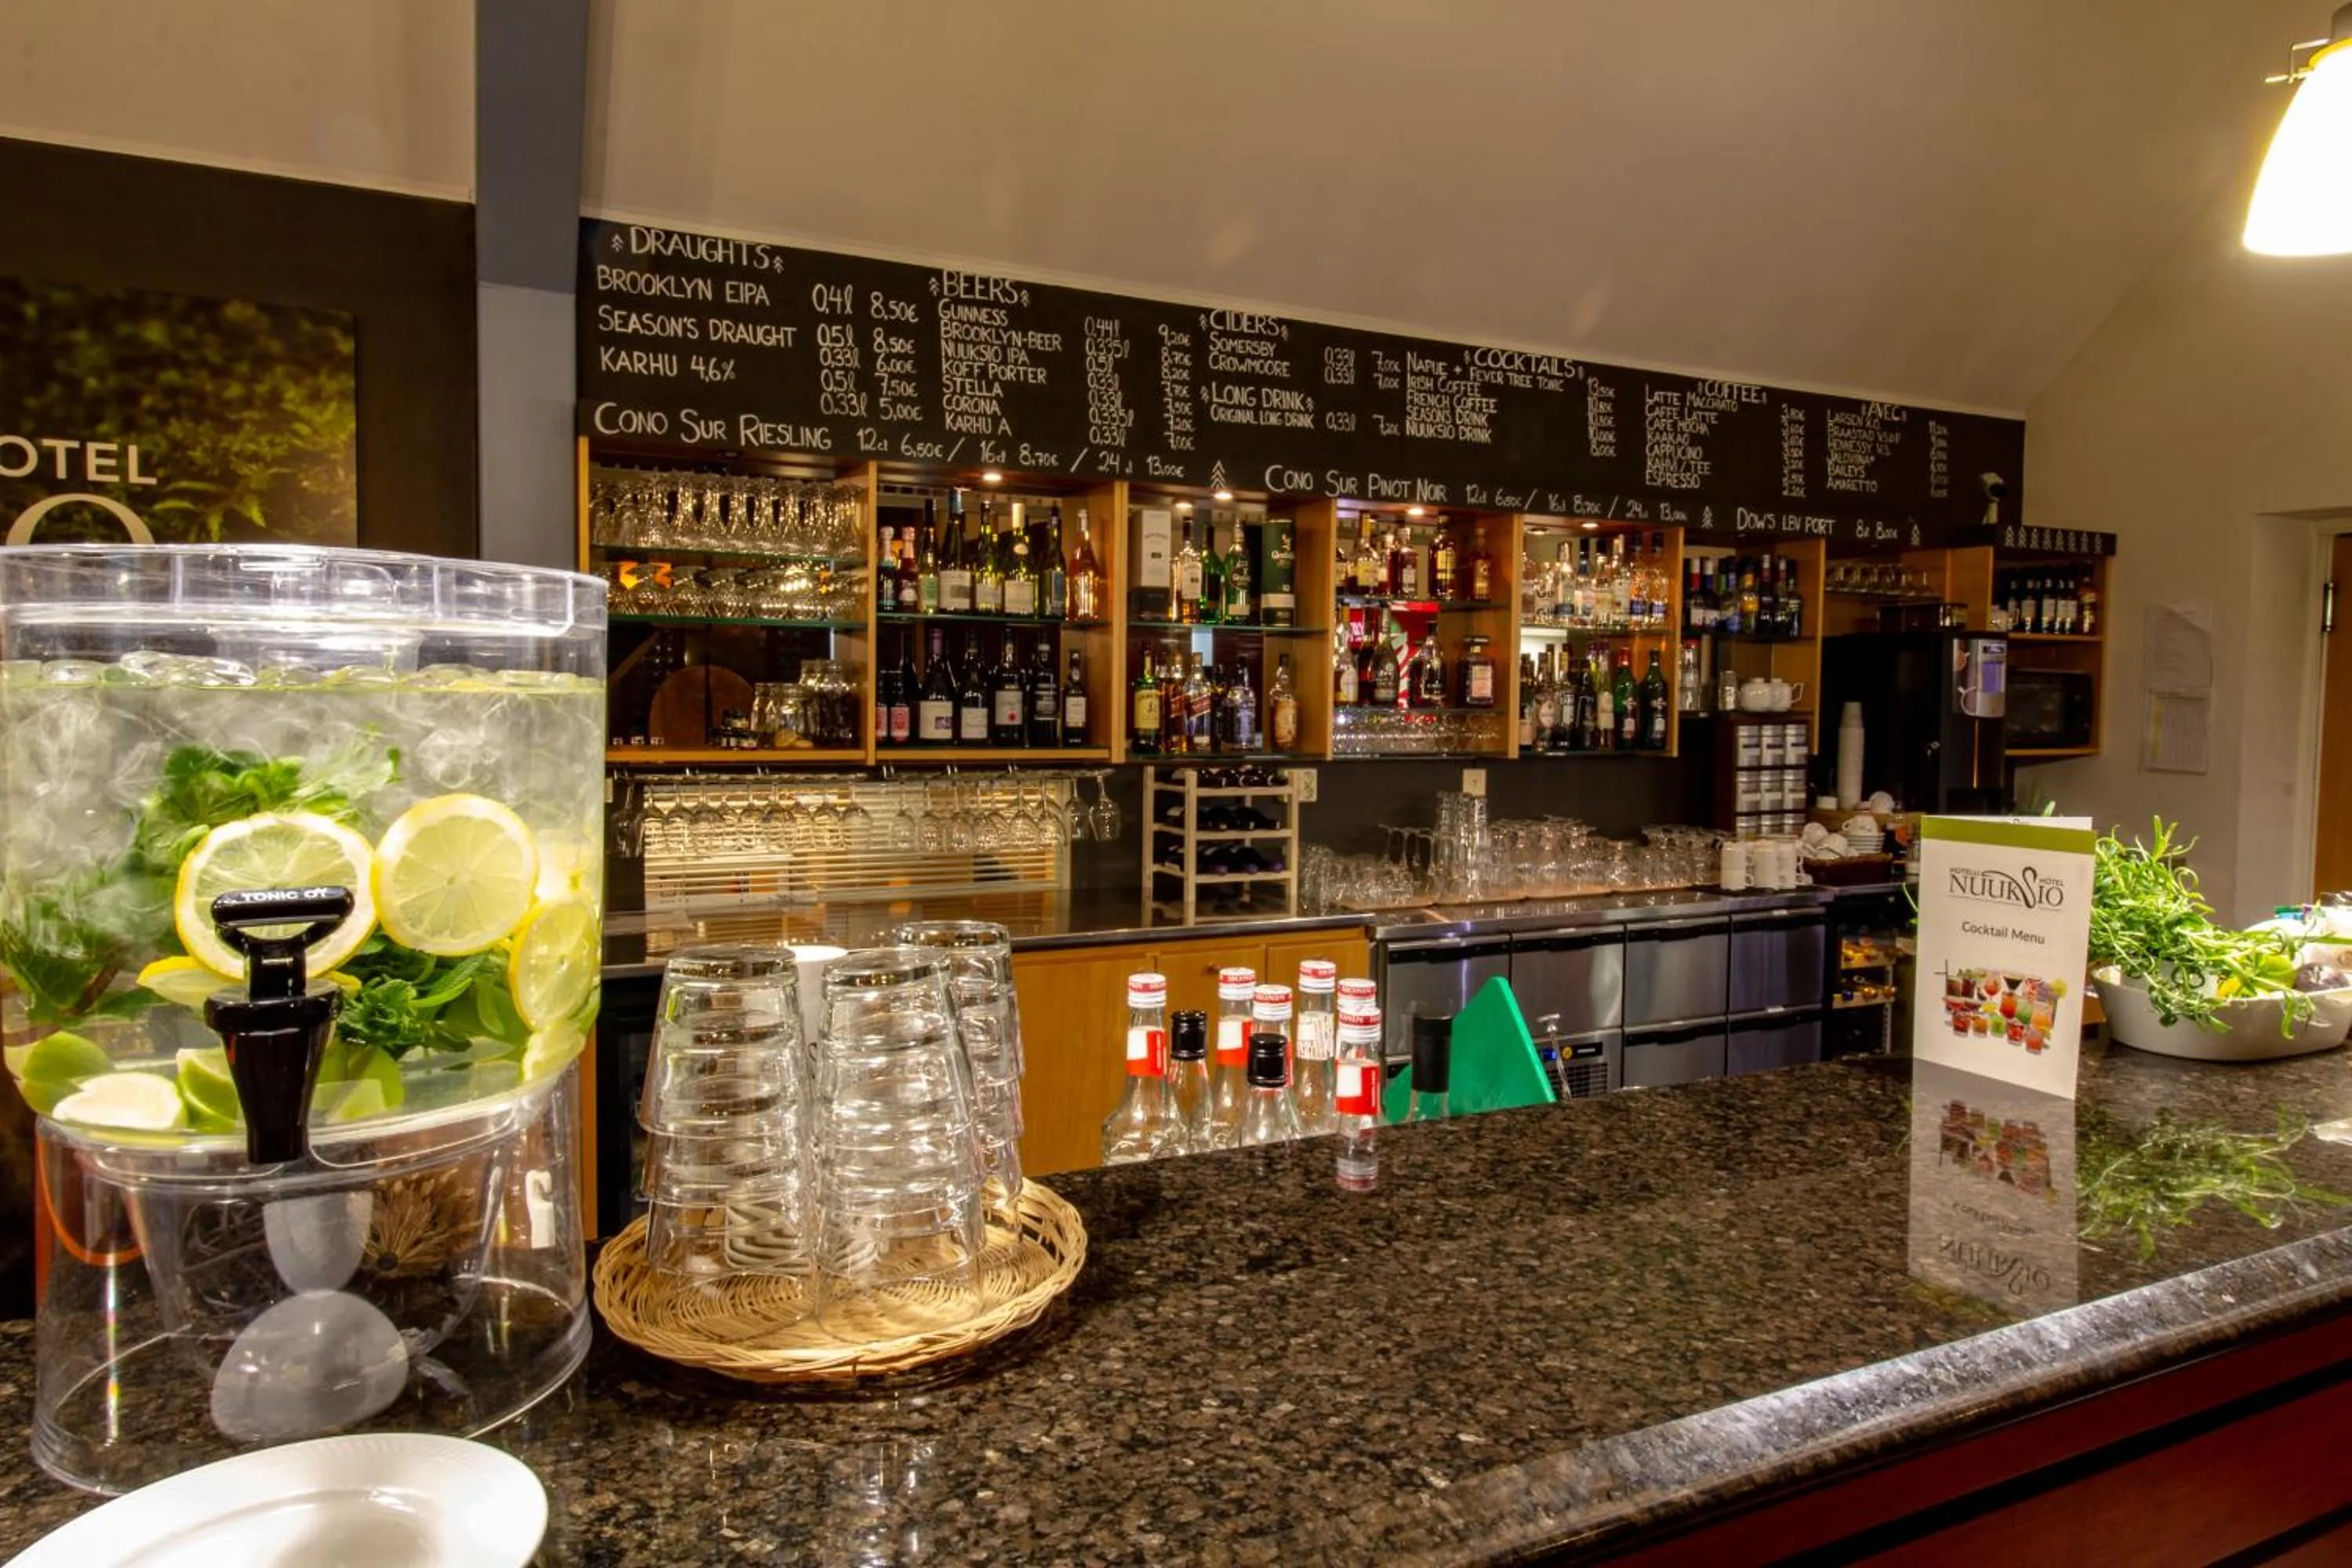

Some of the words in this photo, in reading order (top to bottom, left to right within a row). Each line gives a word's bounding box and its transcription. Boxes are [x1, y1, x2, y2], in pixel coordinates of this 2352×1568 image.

[630, 227, 770, 269] DRAUGHTS
[597, 265, 712, 301] BROOKLYN
[726, 281, 770, 307] EIPA
[943, 270, 1018, 303] BEERS
[938, 299, 1009, 327] GUINNESS
[1210, 309, 1279, 336] CIDERS
[598, 305, 699, 339] SEASON'S
[710, 319, 797, 347] DRAUGHT
[941, 320, 1062, 351] BROOKLYN-BEER
[942, 340, 1002, 363] NUUKSIO
[1007, 347, 1029, 365] IPA
[1209, 332, 1276, 358] SOMERSBY
[600, 347, 677, 376] KARHU
[942, 359, 982, 377] KOFF
[989, 365, 1047, 385] PORTER
[1209, 352, 1291, 377] CROWMOORE
[1474, 347, 1575, 378] COCKTAILS
[942, 377, 1004, 397] STELLA
[1406, 371, 1434, 390] IRISH
[1438, 376, 1481, 397] COFFEE
[1470, 367, 1504, 385] FEVER
[1506, 372, 1533, 389] TREE
[1537, 376, 1565, 393] TONIC
[1705, 381, 1762, 404] COFFEE
[943, 395, 1001, 416] CORONA
[1212, 381, 1256, 406] LONG
[1262, 388, 1305, 412] DRINK
[1406, 390, 1450, 409] FRENCH
[1453, 393, 1498, 414] COFFEE
[1646, 383, 1681, 405] LATTE
[1211, 405, 1258, 424] ORIGINAL
[1286, 412, 1314, 430] DRINK
[1456, 409, 1489, 427] DRINK
[1685, 407, 1719, 424] LATTE
[1867, 401, 1901, 421] AVEC
[595, 401, 667, 434] CONO
[681, 408, 727, 444] SUR
[740, 415, 831, 448] RIESLING
[946, 413, 992, 434] KARHU
[998, 418, 1011, 436] A
[1406, 420, 1454, 440] NUUKSIO
[1459, 426, 1492, 444] DRINK
[1678, 419, 1710, 437] MOCHA
[1647, 430, 1690, 445] KAAKAO
[1646, 470, 1701, 488] ESPRESSO
[1690, 461, 1712, 475] TEE
[1265, 464, 1313, 492] CONO
[1325, 470, 1358, 497] SUR
[1368, 473, 1411, 499] PINOT
[1417, 477, 1448, 502] NOIR
[1804, 516, 1836, 535] PORT
[241, 890, 299, 902] TONIC
[1948, 866, 2064, 909] NUUKSIO
[1962, 921, 2008, 938] Cocktail
[2012, 928, 2045, 945] Menu
